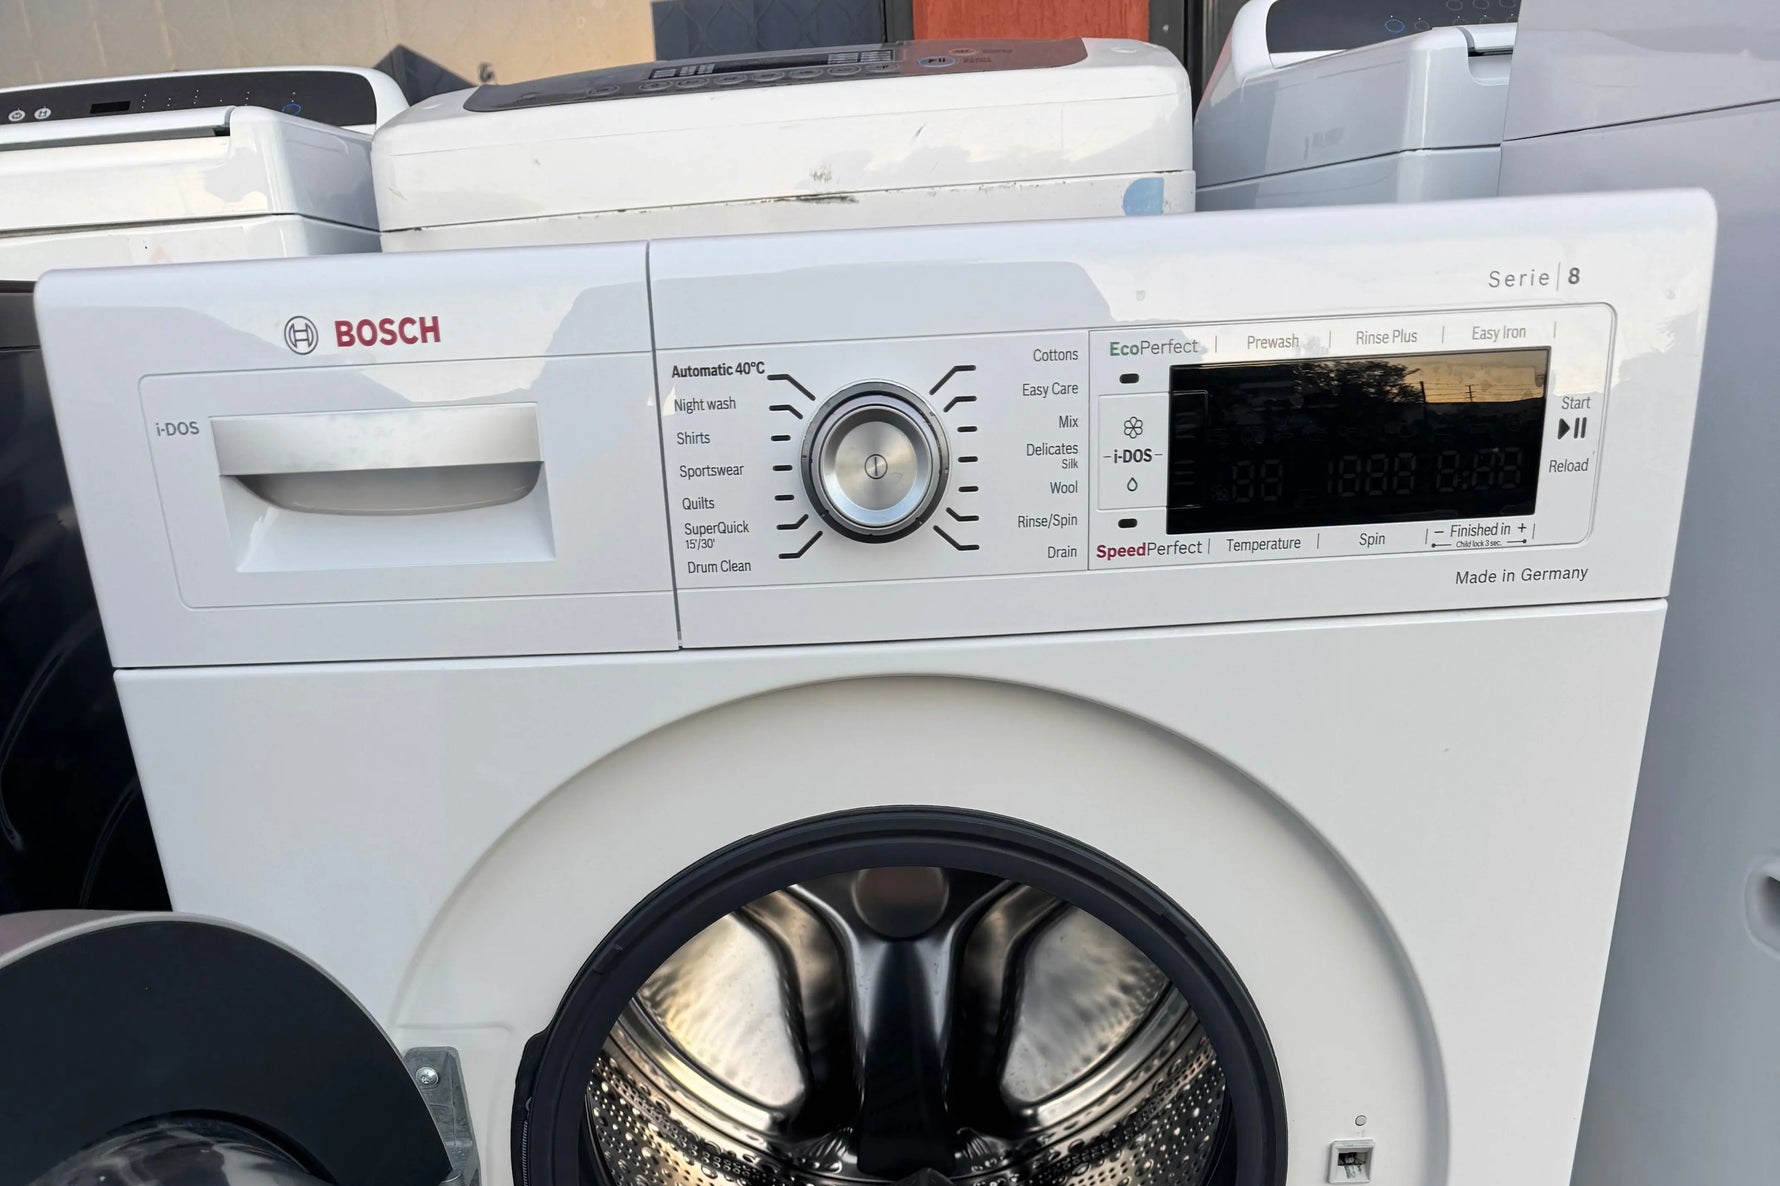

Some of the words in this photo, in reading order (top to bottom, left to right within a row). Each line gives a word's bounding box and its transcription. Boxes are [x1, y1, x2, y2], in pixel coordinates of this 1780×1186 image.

[1488, 268, 1550, 289] Serie
[1567, 267, 1581, 285] 8
[334, 315, 441, 348] BOSCH
[1356, 330, 1390, 345] Rinse
[1392, 328, 1418, 344] Plus
[1472, 326, 1500, 342] Easy
[1503, 325, 1527, 339] Iron
[1109, 338, 1199, 357] EcoPerfect
[1247, 333, 1300, 350] Prewash
[1033, 348, 1079, 362] Cottons
[671, 363, 733, 378] Automatic
[735, 361, 765, 376] 40°C
[1022, 383, 1049, 398] Easy
[1052, 381, 1079, 395] Care
[674, 397, 705, 414] Night
[706, 396, 737, 411] wash
[1561, 396, 1592, 410] Start
[155, 421, 200, 437] i-DOS
[1058, 415, 1079, 429] Mix
[676, 431, 711, 445] Shirts
[1026, 442, 1079, 456] Delicates
[1113, 448, 1153, 464] i-DOS
[679, 464, 745, 480] Sportswear
[1061, 458, 1079, 470] Silk
[1548, 457, 1590, 473] Reload
[1049, 480, 1078, 494] Wool
[682, 496, 715, 511] Quilts
[684, 520, 750, 537] SuperQuick
[1017, 513, 1078, 529] Rinse/Spin
[1450, 522, 1499, 538] Finished
[1500, 523, 1511, 536] in
[1226, 536, 1302, 554] Temperature
[1359, 532, 1386, 548] Spin
[1455, 540, 1471, 548] Child
[1472, 539, 1485, 547] lock
[1047, 545, 1078, 559] Drain
[1096, 540, 1203, 561] SpeedPerfect
[687, 561, 718, 574] Drum
[720, 559, 752, 572] Clean
[1455, 570, 1497, 585] Made
[1502, 569, 1515, 583] in
[1521, 567, 1589, 582] Germany
